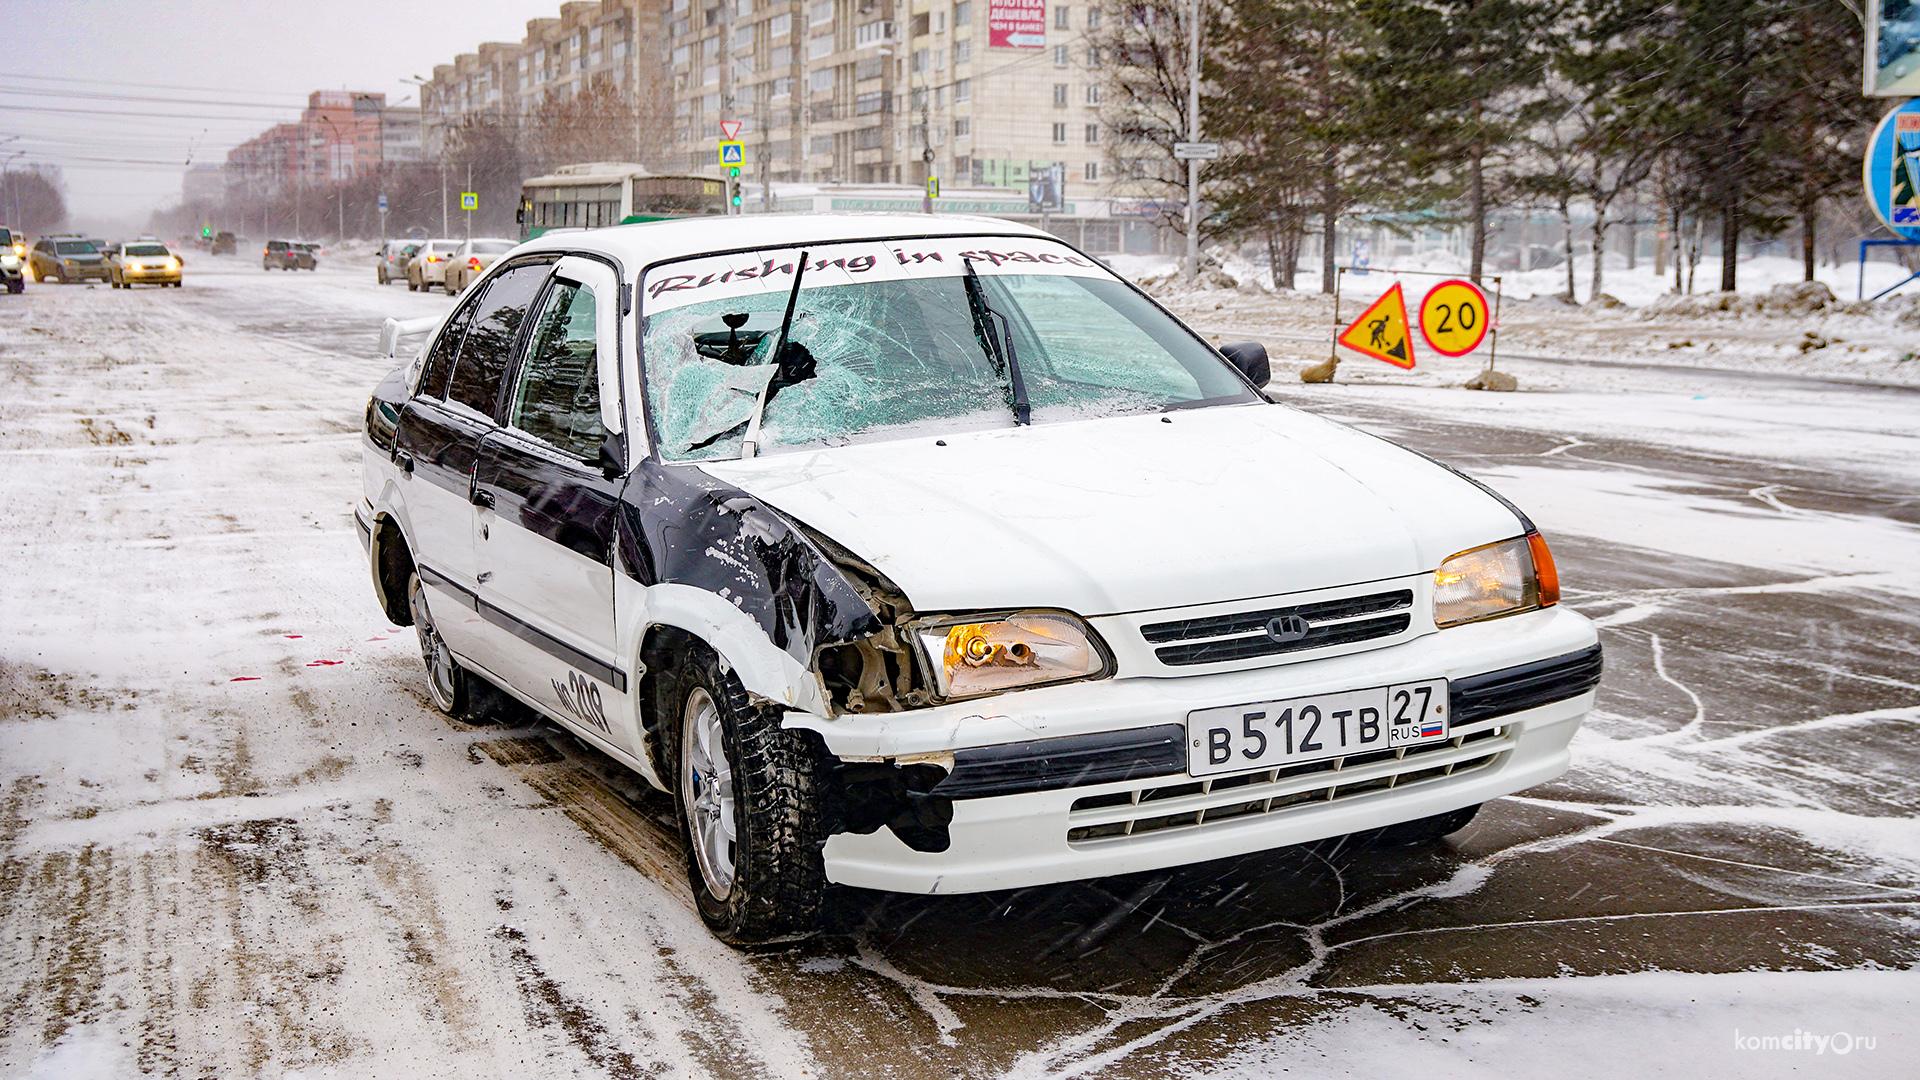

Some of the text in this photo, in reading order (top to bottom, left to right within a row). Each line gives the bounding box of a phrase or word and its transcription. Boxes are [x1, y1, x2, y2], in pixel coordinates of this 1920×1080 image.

[990, 21, 1007, 31] ЧЕМ
[1008, 22, 1015, 31] В
[893, 248, 944, 265] in
[958, 249, 1095, 267] space
[1436, 302, 1475, 333] 20
[1394, 686, 1432, 725] 27
[1390, 726, 1420, 741] RUS
